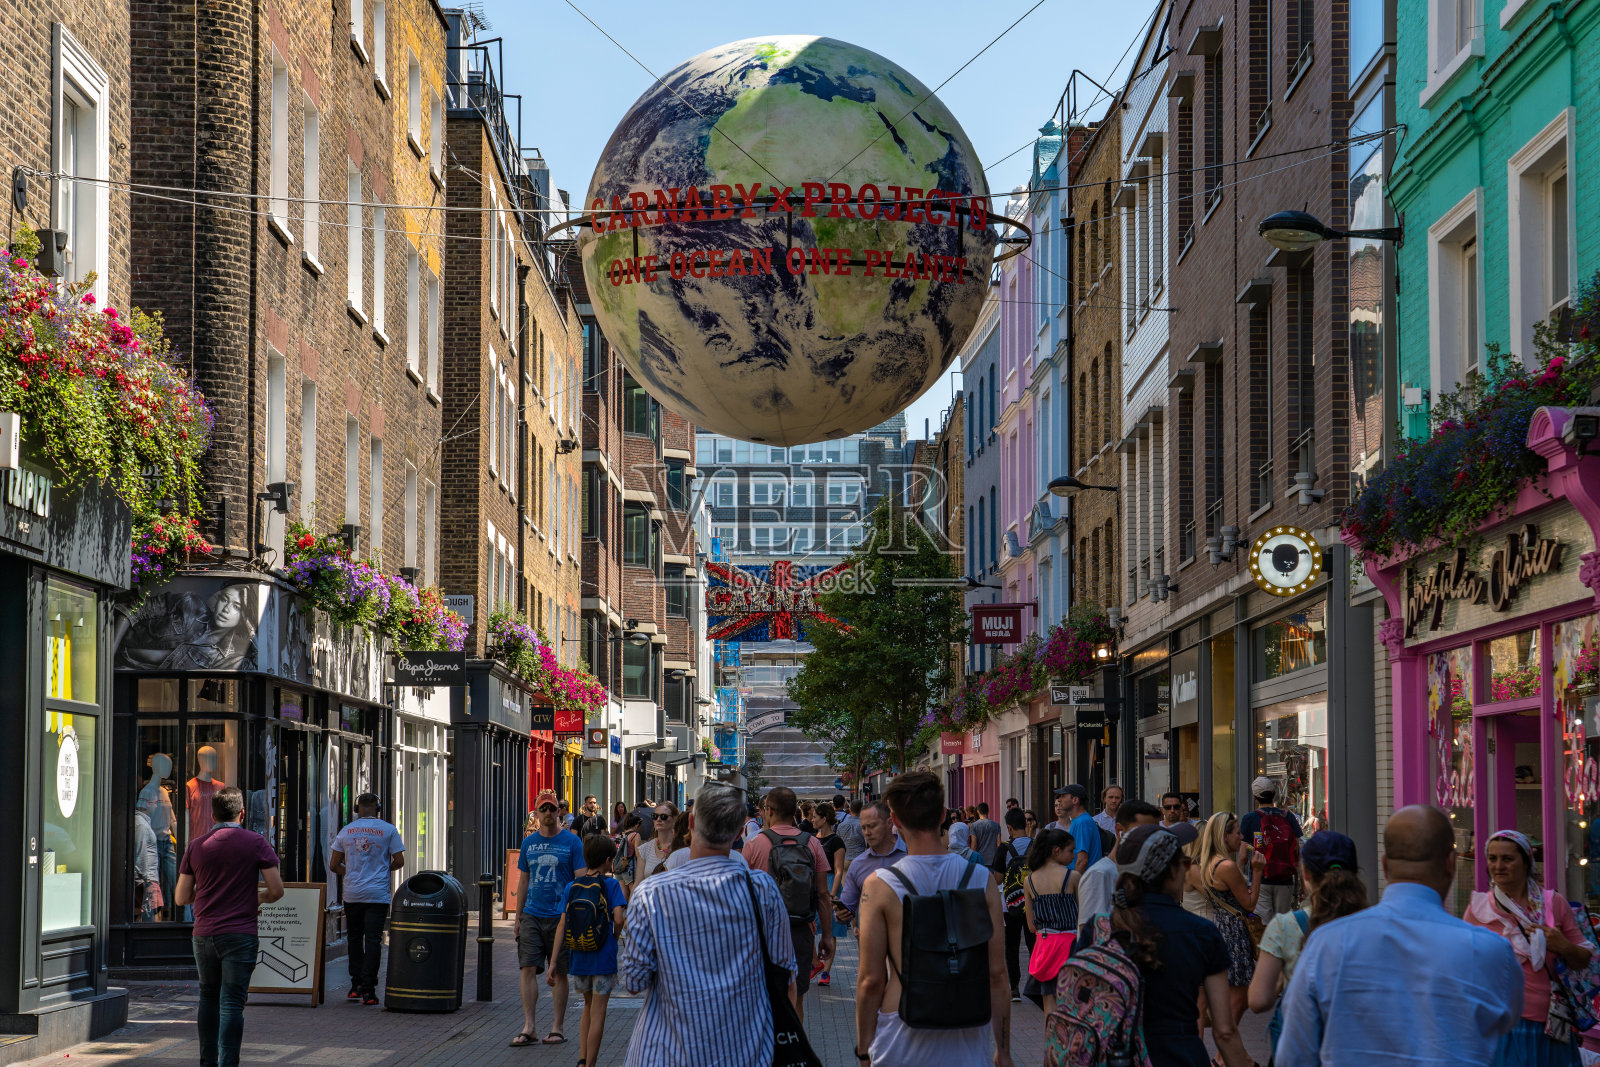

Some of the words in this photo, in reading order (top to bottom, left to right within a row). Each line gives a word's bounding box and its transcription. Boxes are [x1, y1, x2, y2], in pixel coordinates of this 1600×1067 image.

[591, 183, 762, 233] CARNABY
[801, 182, 963, 227] PROJECT
[610, 255, 658, 287] ONE
[670, 248, 773, 280] OCEAN
[786, 247, 851, 275] ONE
[863, 250, 967, 285] PLANET
[708, 586, 824, 612] CARNA
[982, 616, 1014, 630] MUJI
[398, 659, 425, 676] Pepe
[425, 659, 460, 676] Jeans
[555, 713, 582, 727] Ray-Ban
[528, 843, 550, 851] AT-AT
